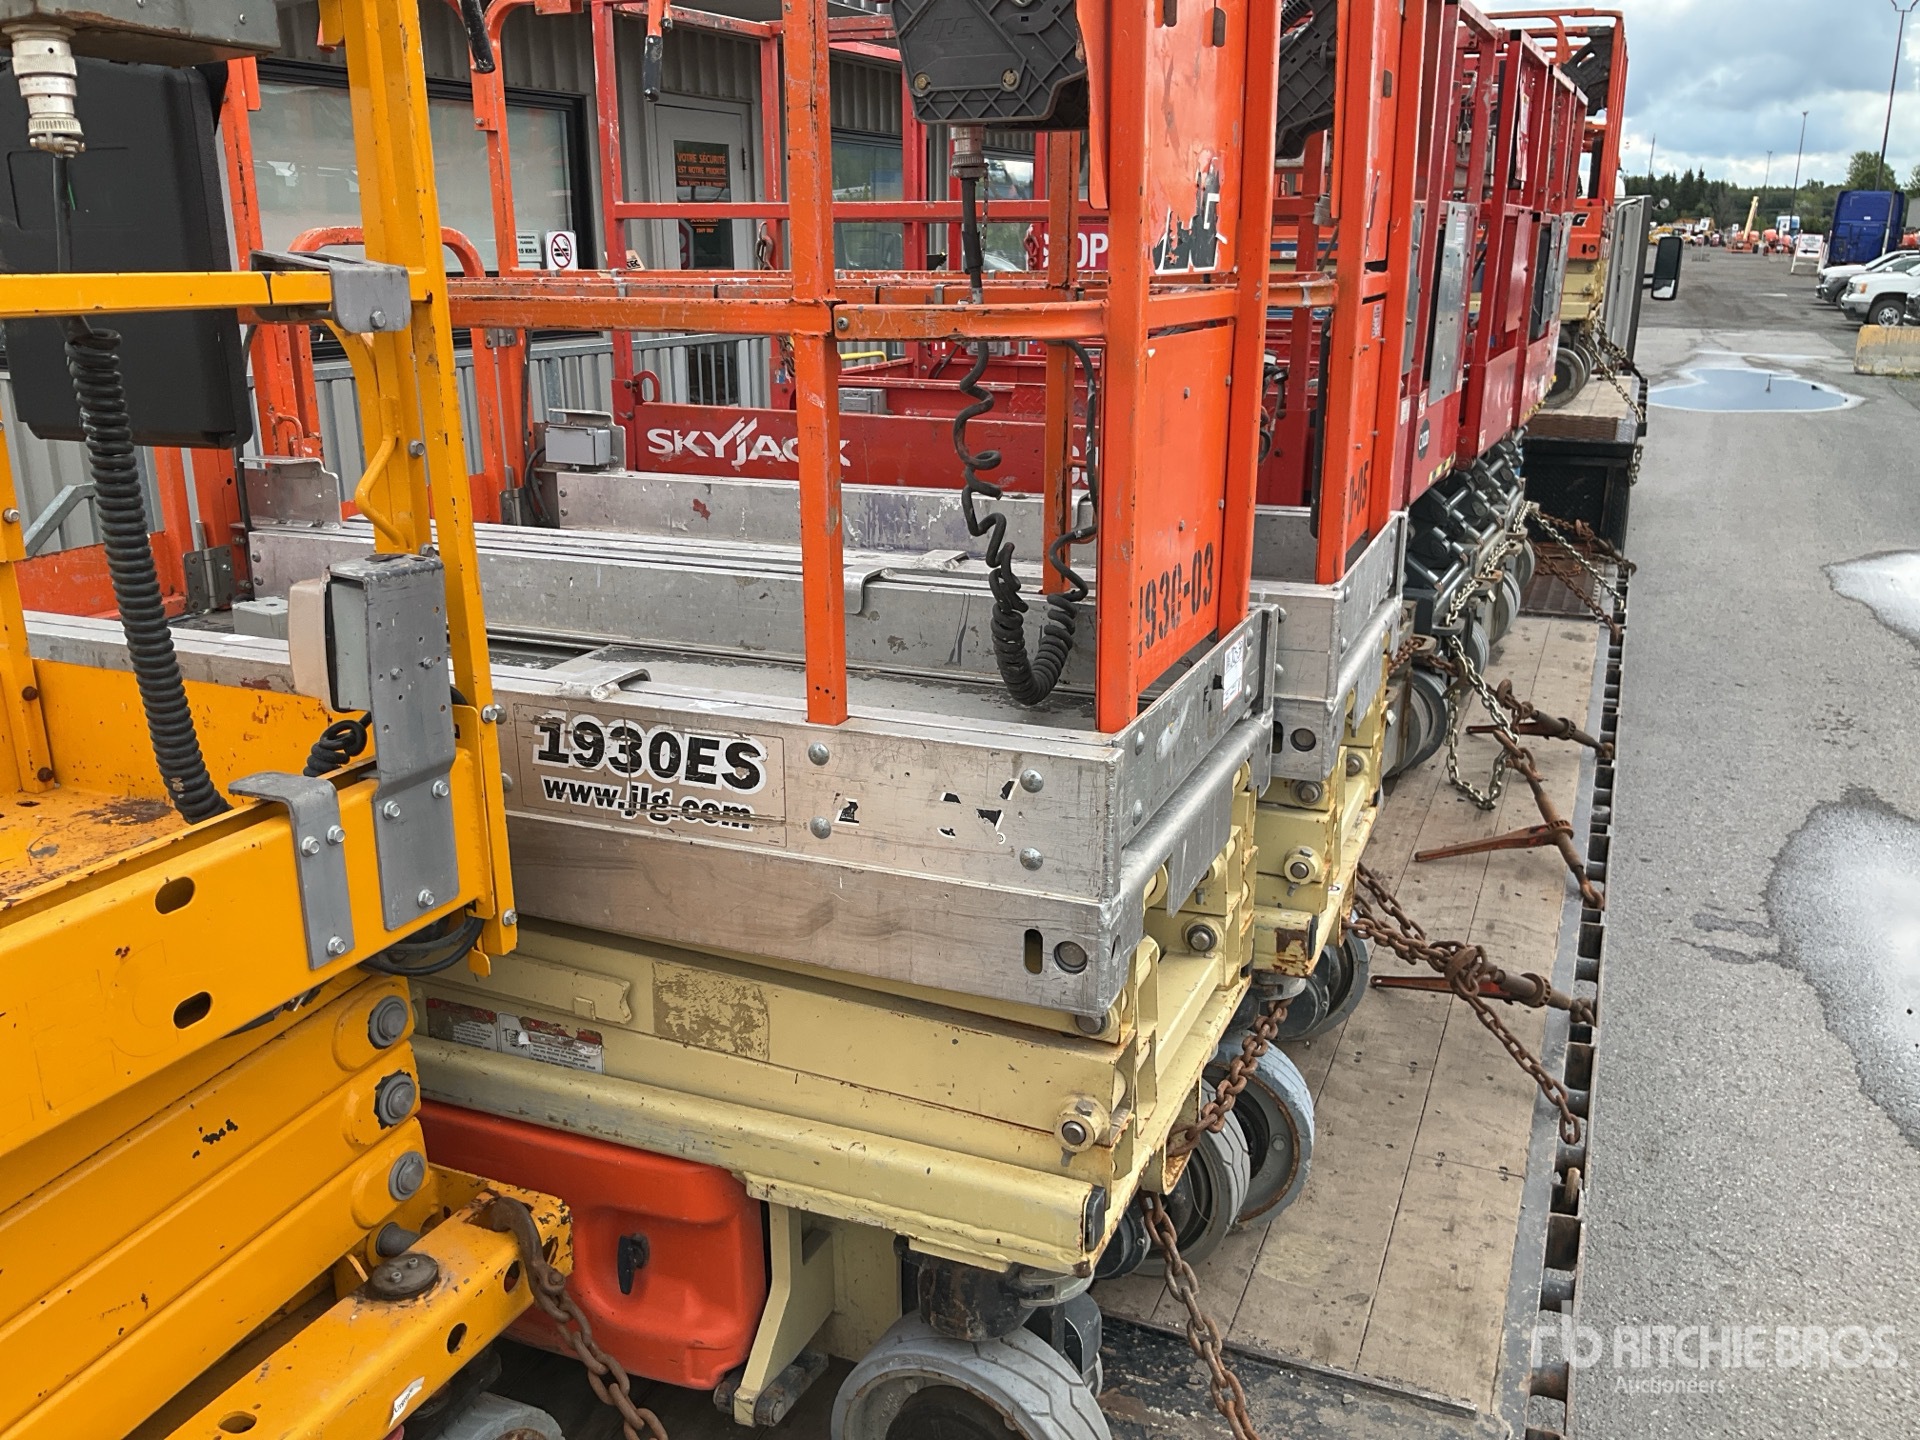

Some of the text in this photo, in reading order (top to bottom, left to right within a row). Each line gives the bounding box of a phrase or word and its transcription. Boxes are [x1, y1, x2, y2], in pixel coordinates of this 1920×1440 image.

[676, 152, 726, 165] VOTRE SÉCURITÉ
[688, 166, 704, 174] NOTRE
[537, 715, 764, 791] 1930ES
[543, 779, 751, 829] www.jlg.com
